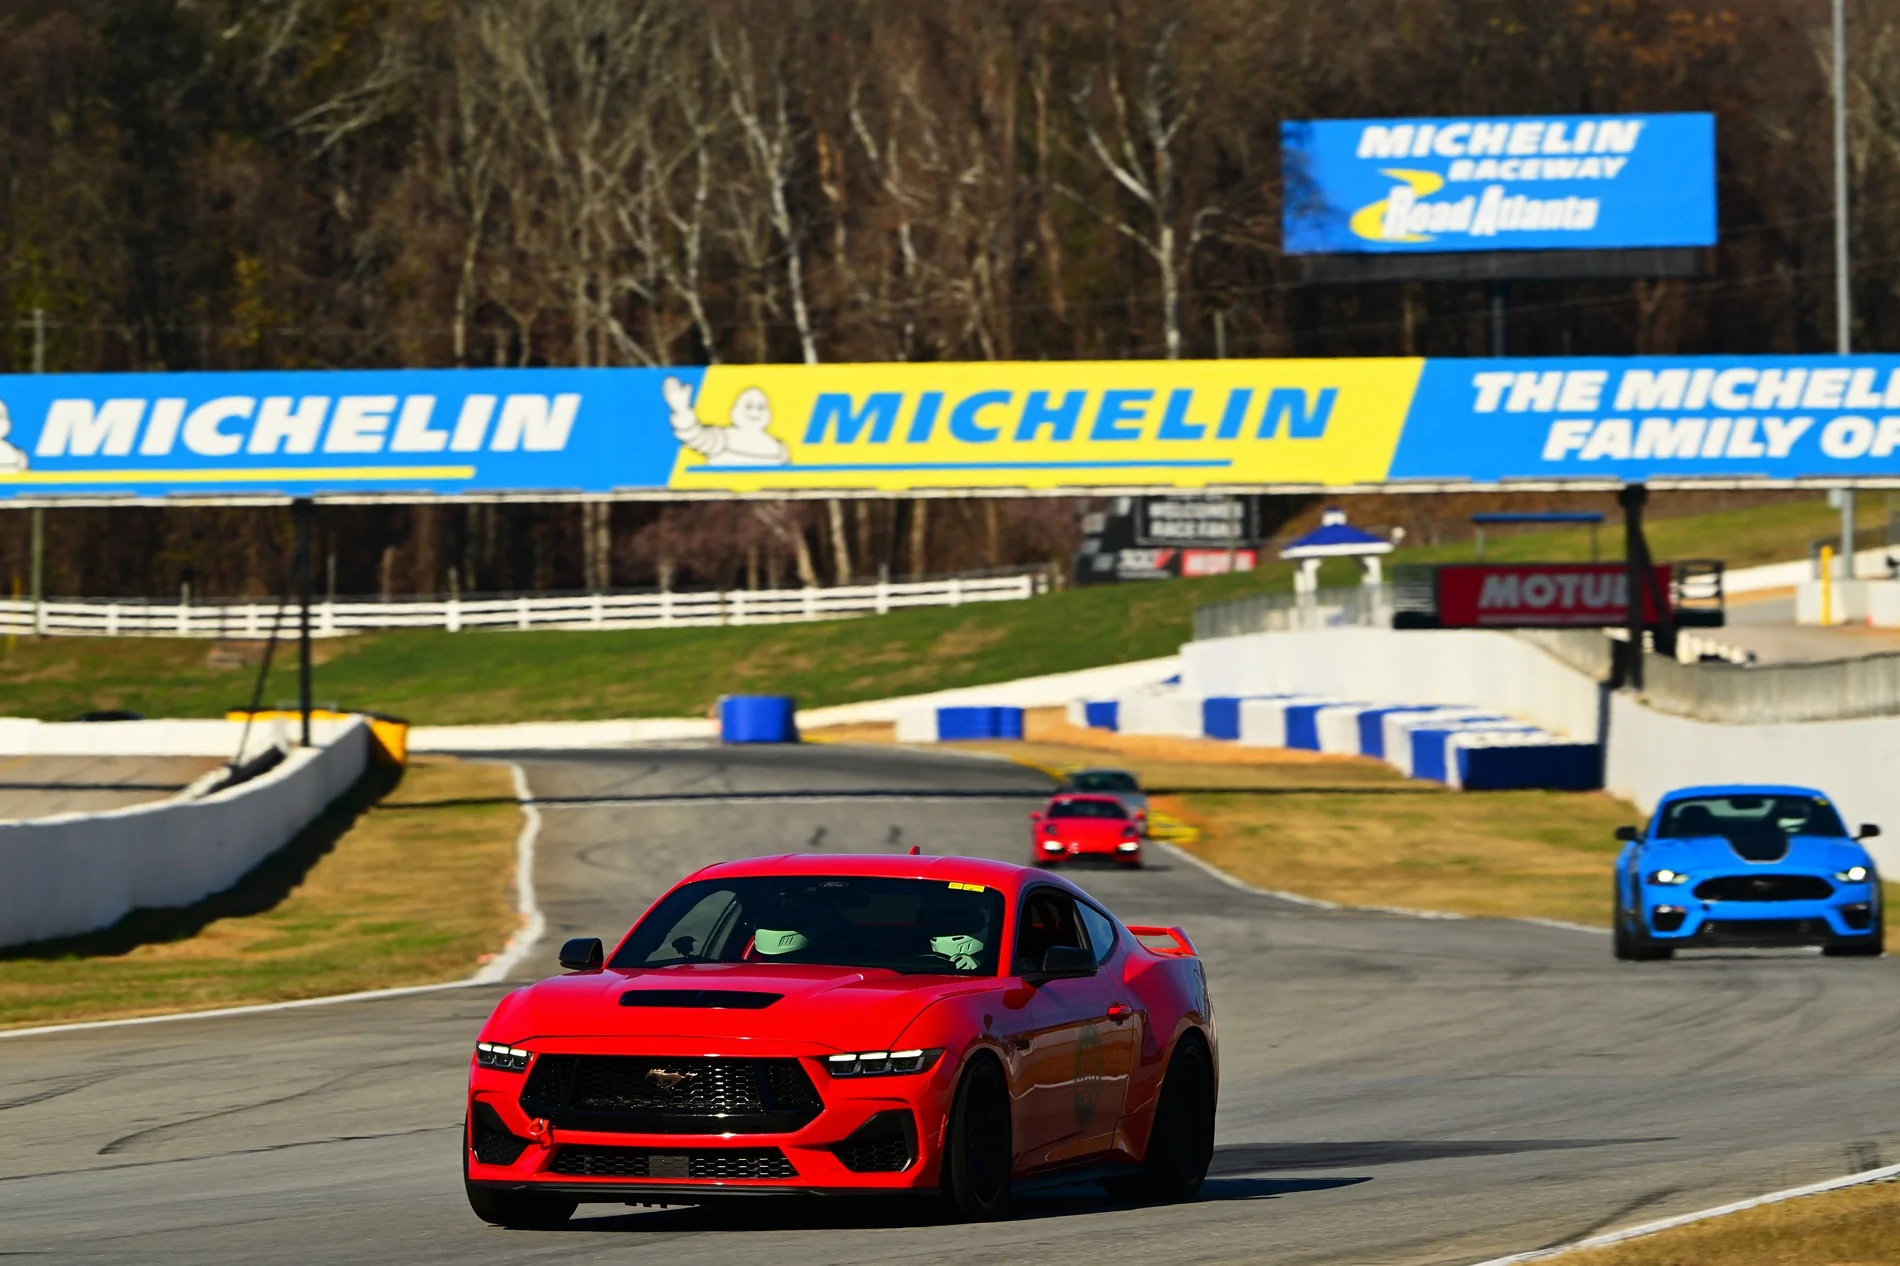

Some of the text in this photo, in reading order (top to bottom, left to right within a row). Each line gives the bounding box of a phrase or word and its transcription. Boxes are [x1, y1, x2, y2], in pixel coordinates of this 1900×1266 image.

[1357, 120, 1643, 159] MICHELIN
[1448, 156, 1628, 181] RACEWAY
[1381, 185, 1600, 238] Road Atlanta
[1473, 370, 1608, 413] THE
[35, 394, 581, 456] MICHELIN
[804, 388, 1338, 444] MICHELIN
[1542, 416, 1815, 461] FAMILY
